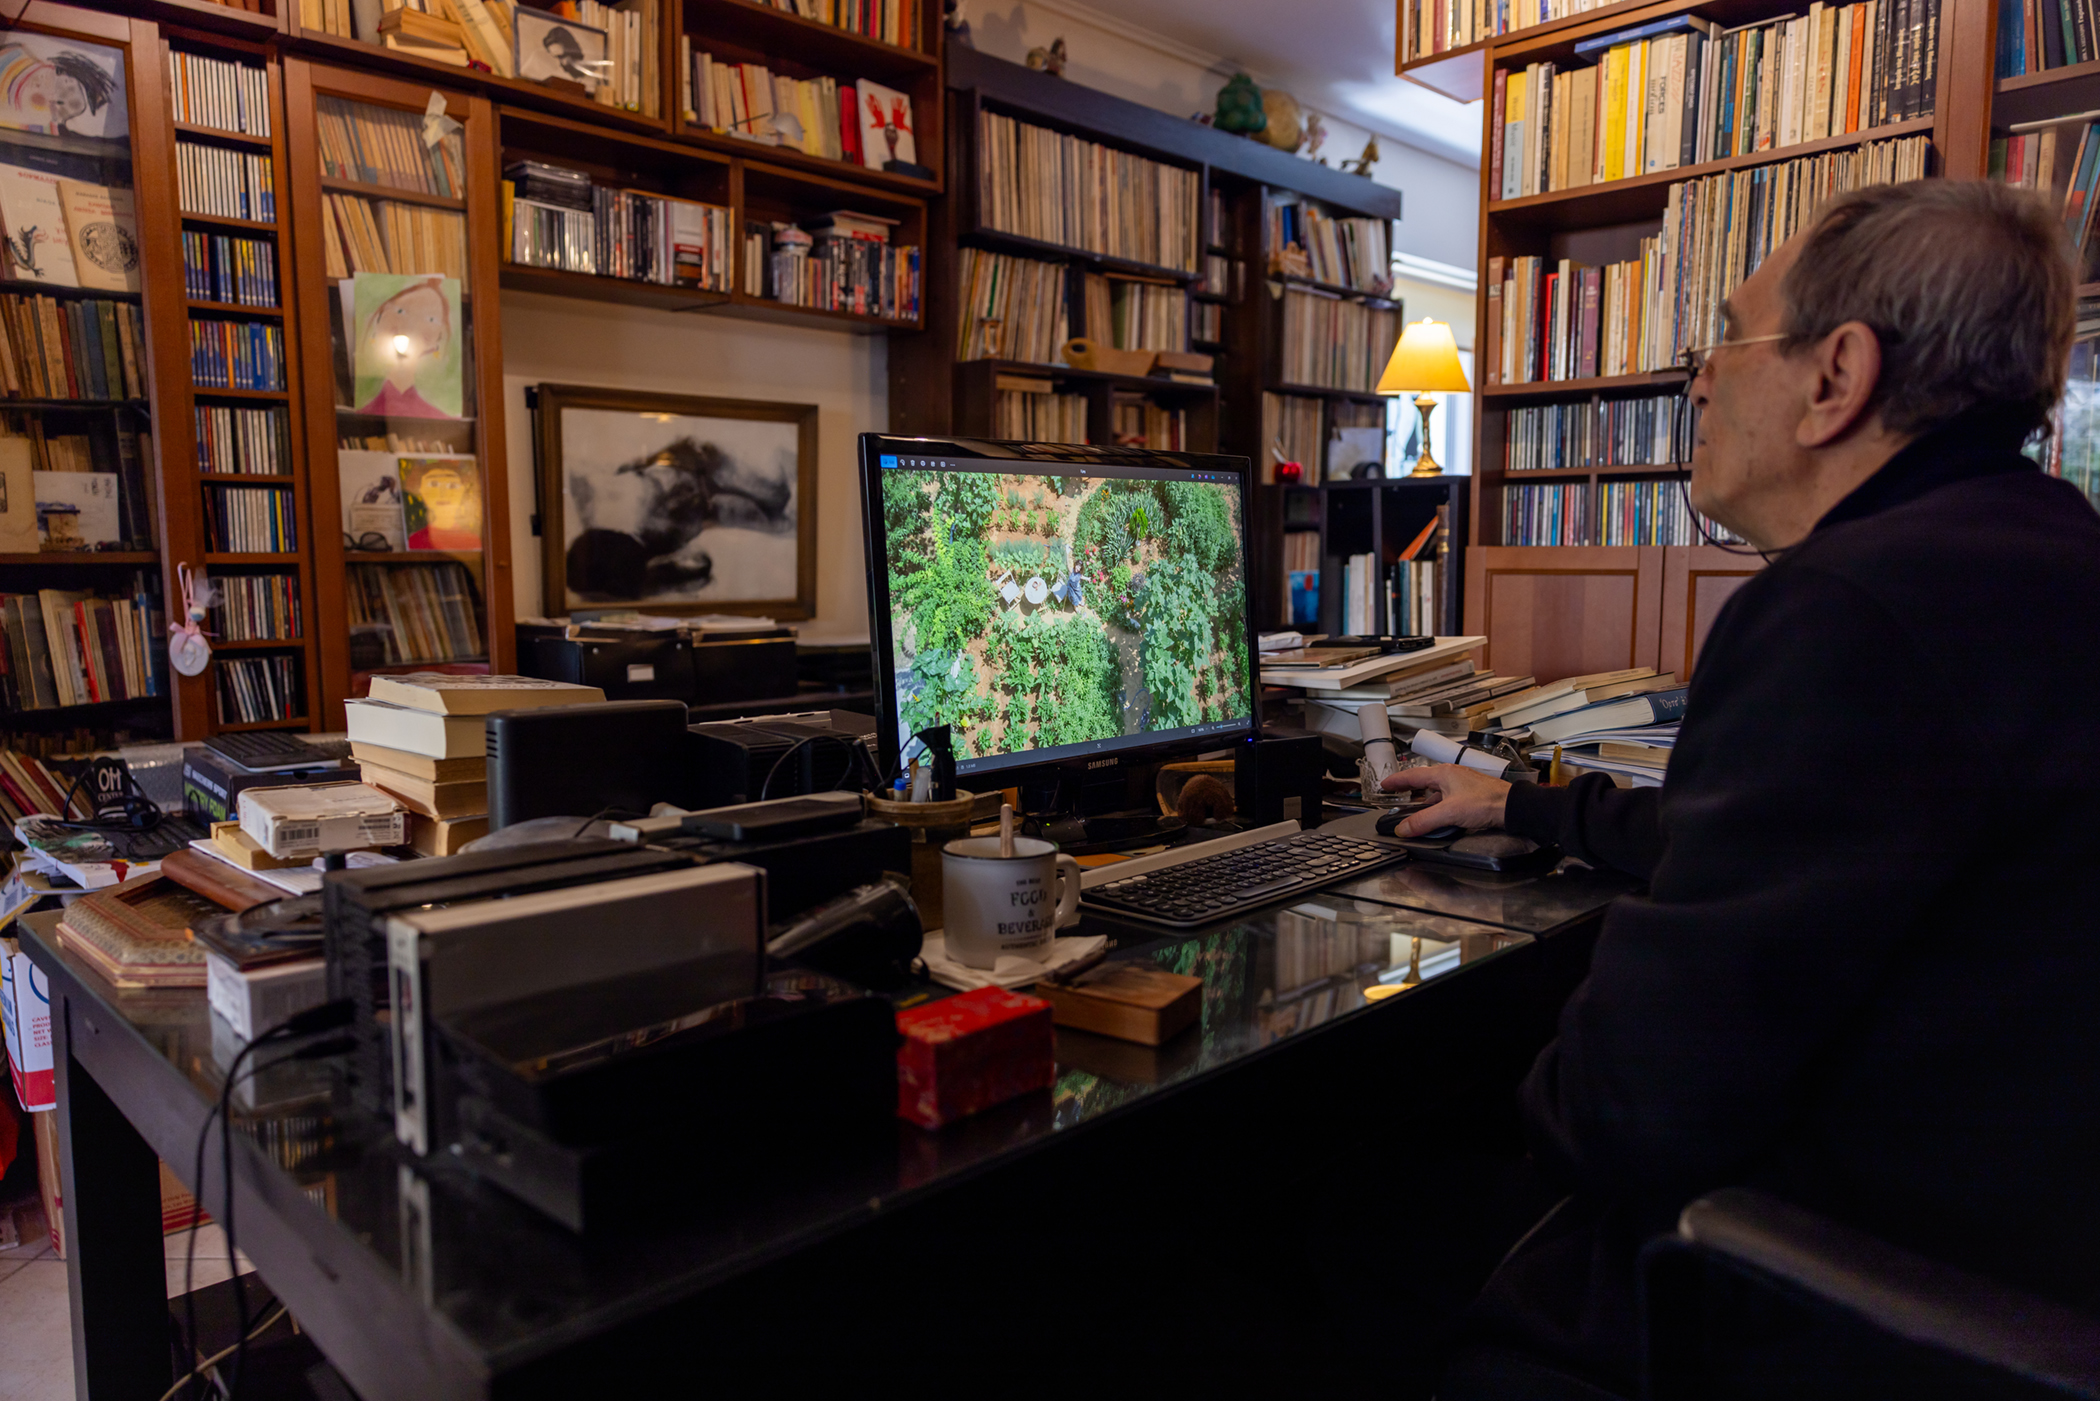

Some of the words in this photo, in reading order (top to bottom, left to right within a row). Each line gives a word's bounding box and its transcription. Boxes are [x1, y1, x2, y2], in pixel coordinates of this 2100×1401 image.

[1658, 76, 1667, 114] FORCES
[1511, 95, 1520, 121] World
[1510, 123, 1519, 148] Music
[1087, 757, 1119, 770] SAMSUNG
[98, 766, 122, 792] OM
[1010, 889, 1048, 907] FOOD
[1027, 908, 1035, 918] &
